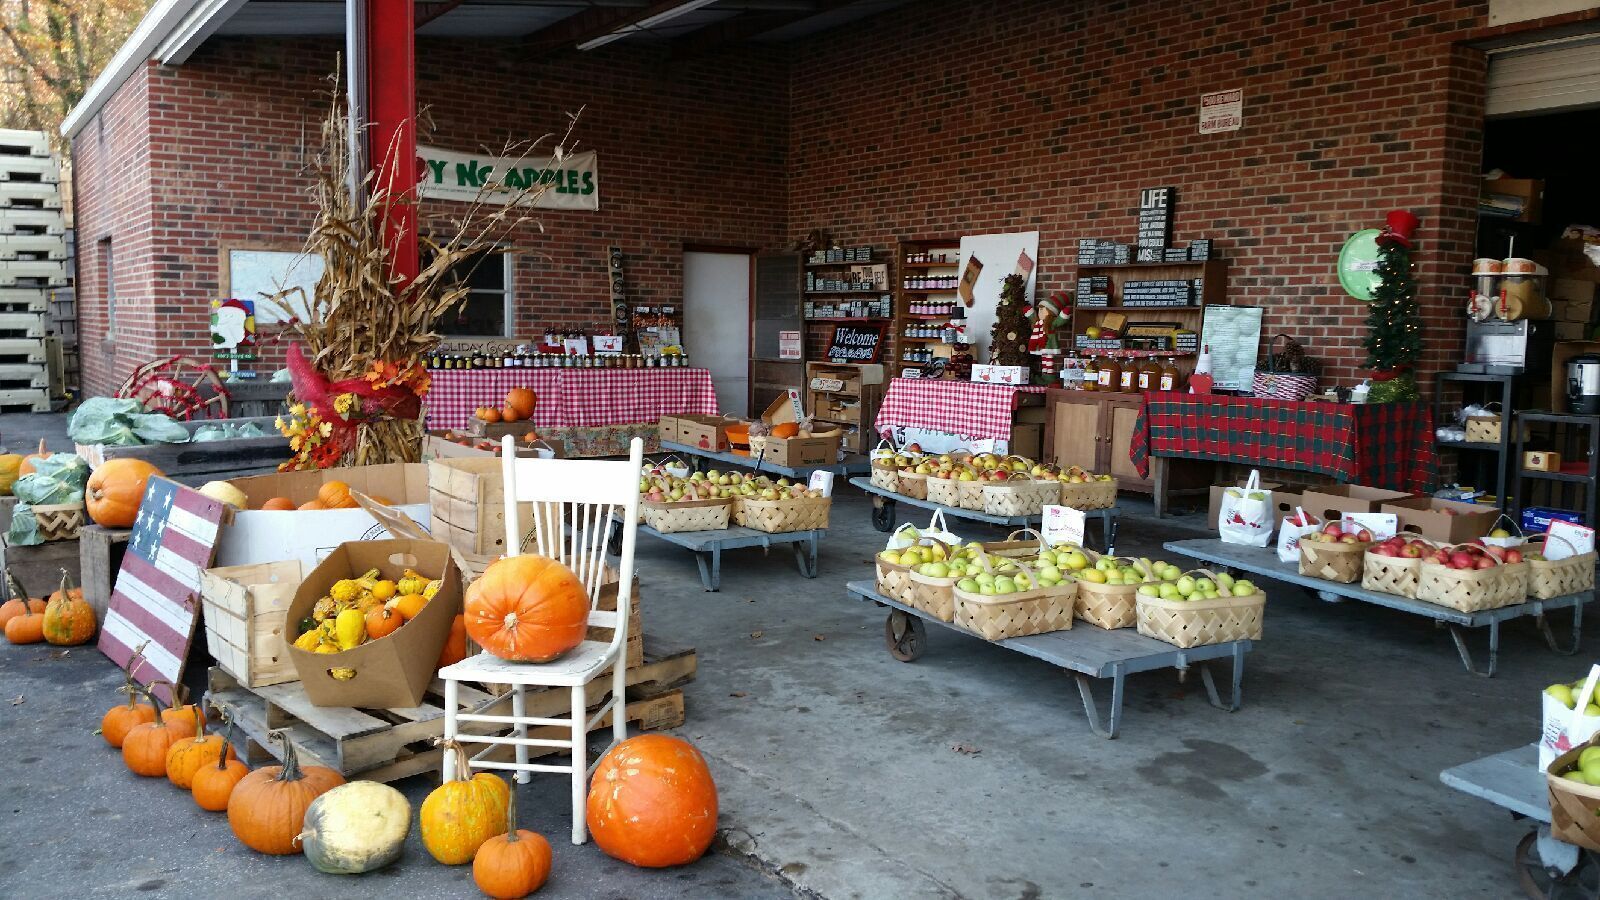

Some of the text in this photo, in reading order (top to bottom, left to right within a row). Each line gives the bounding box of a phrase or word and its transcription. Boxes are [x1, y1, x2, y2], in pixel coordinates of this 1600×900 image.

[1141, 188, 1167, 208] LIFE
[836, 327, 879, 346] Welcome
[442, 342, 483, 352] OLIDAY
